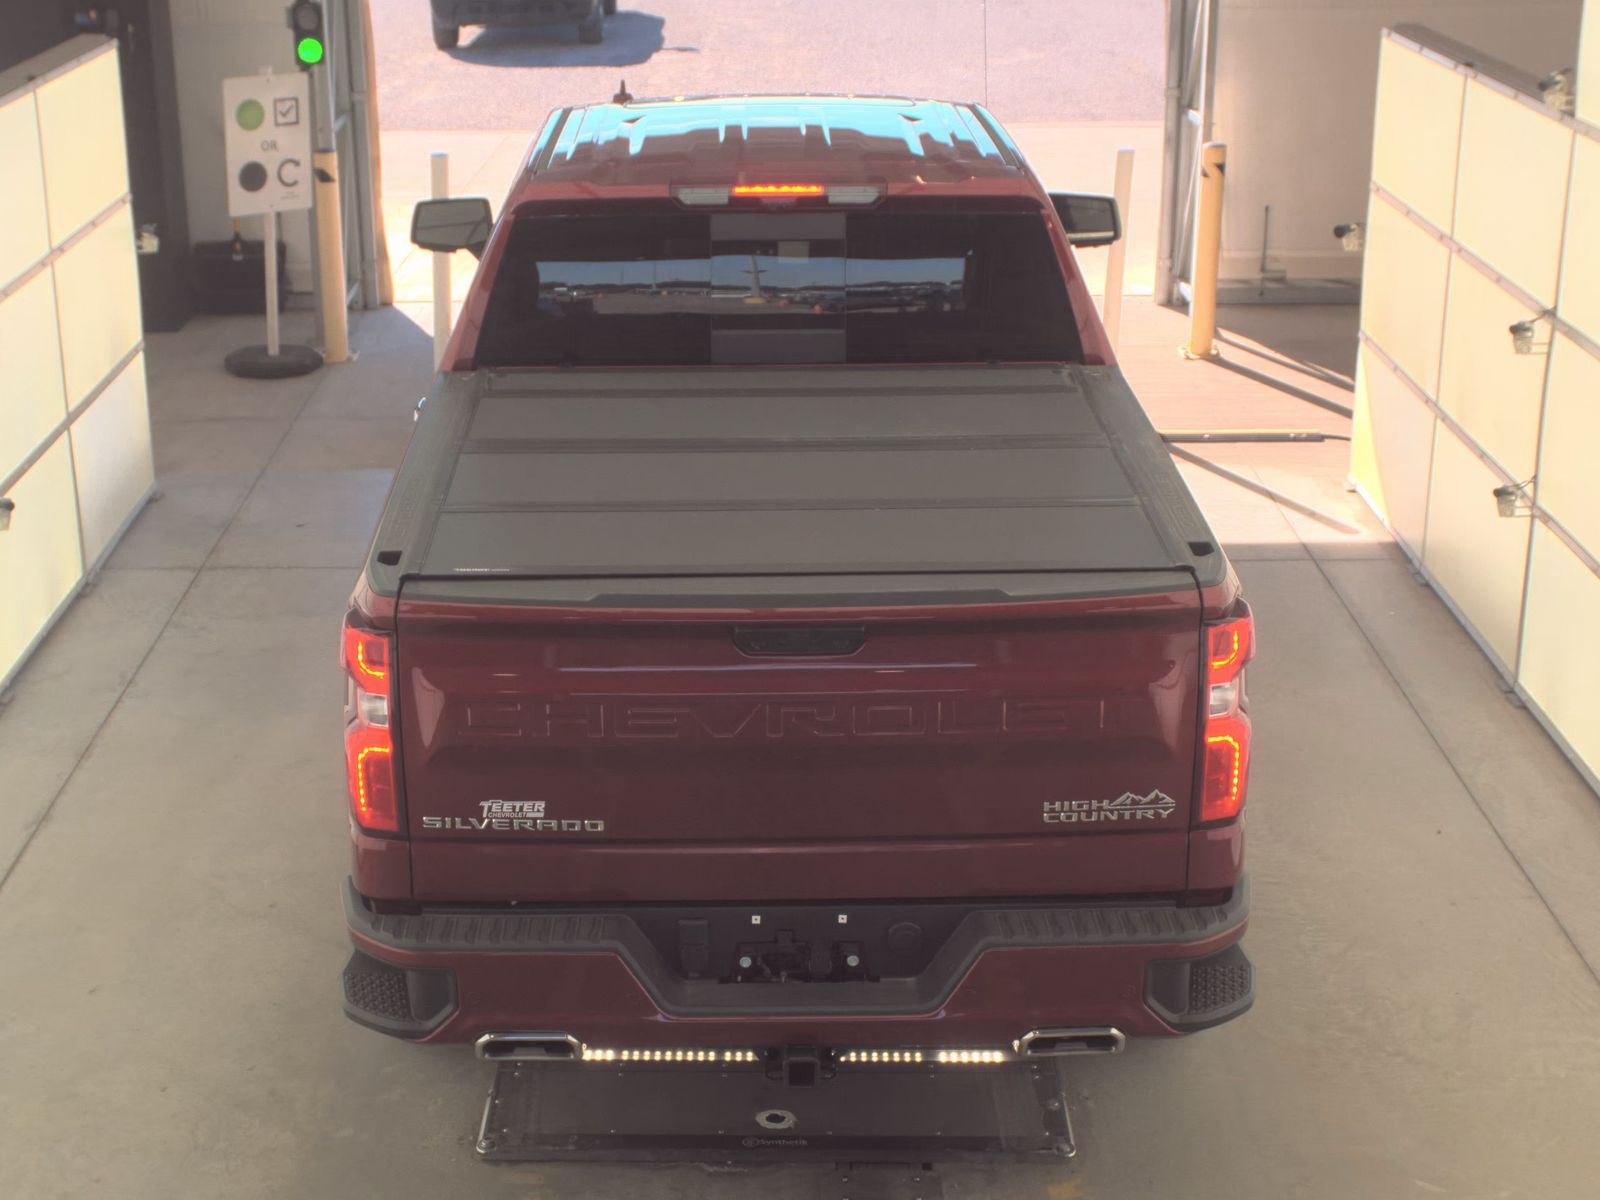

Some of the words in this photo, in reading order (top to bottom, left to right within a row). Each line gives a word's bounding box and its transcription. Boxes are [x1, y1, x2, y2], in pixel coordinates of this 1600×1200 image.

[261, 140, 278, 151] OR
[457, 699, 1128, 738] CHEVROLET
[480, 800, 545, 817] TEETER
[1043, 799, 1110, 811] HIGH
[1043, 808, 1175, 822] COUNTRY
[422, 816, 605, 832] SILVERADO
